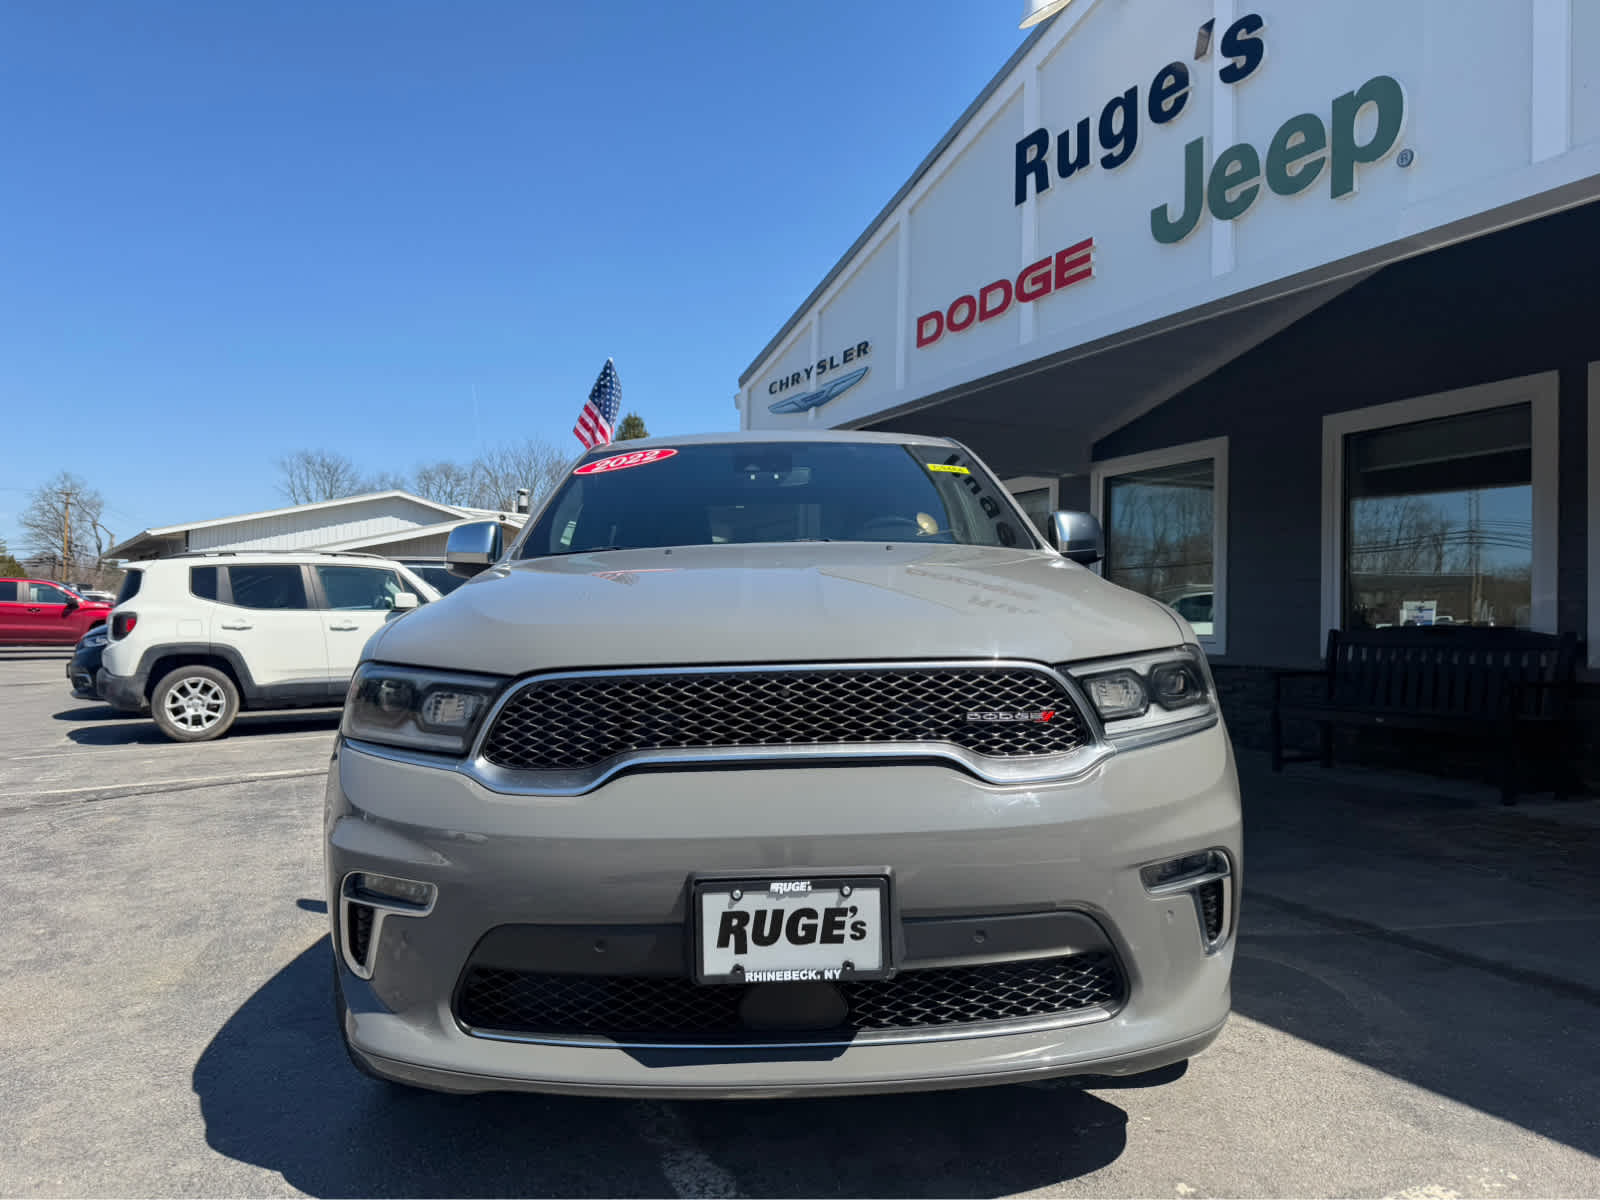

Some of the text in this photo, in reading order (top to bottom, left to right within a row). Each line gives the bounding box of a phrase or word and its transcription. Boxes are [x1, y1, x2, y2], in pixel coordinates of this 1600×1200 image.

[1015, 13, 1264, 206] Ruge's
[1151, 75, 1405, 244] Jeep
[916, 237, 1094, 349] DODGE
[768, 340, 871, 396] CHRYSLER
[592, 450, 661, 472] 2022
[717, 906, 867, 955] RUGE's
[824, 969, 841, 980] NY
